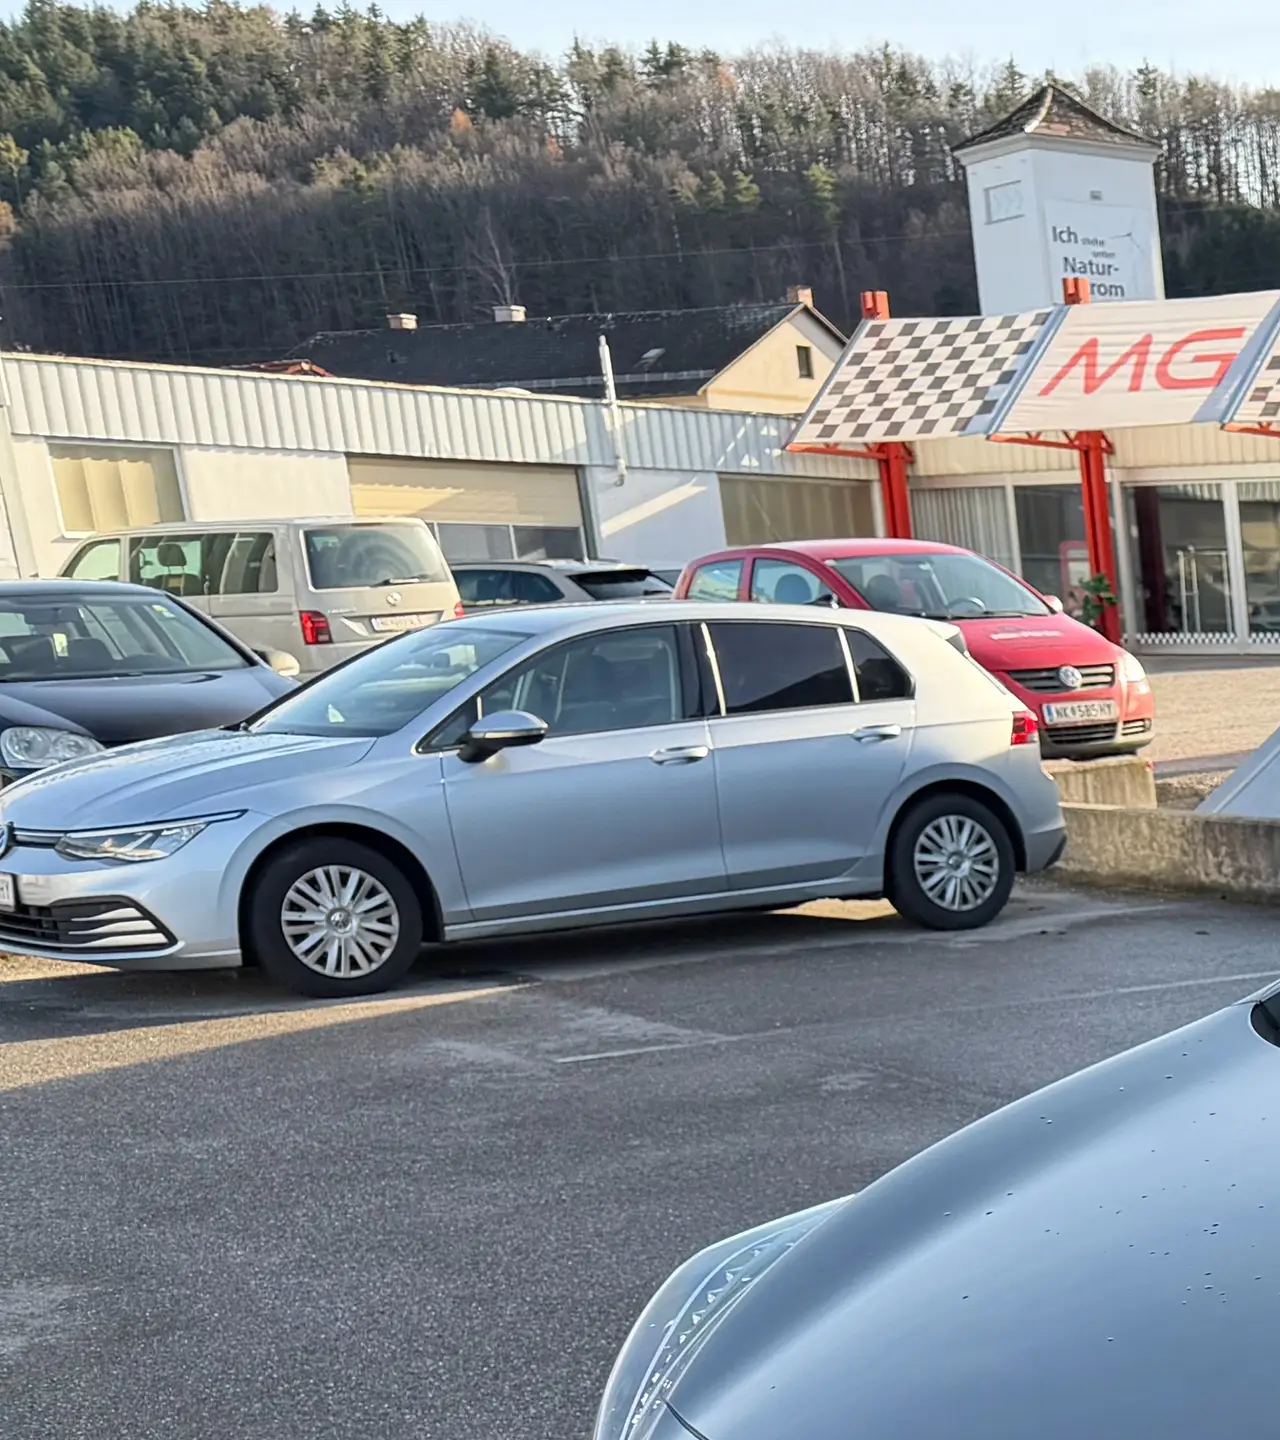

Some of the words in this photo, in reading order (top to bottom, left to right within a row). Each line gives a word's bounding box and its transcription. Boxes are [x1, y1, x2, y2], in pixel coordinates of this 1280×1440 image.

[1052, 226, 1079, 244] Ich
[1063, 256, 1119, 275] Natur-
[1090, 282, 1125, 297] rom
[1038, 326, 1247, 397] MG
